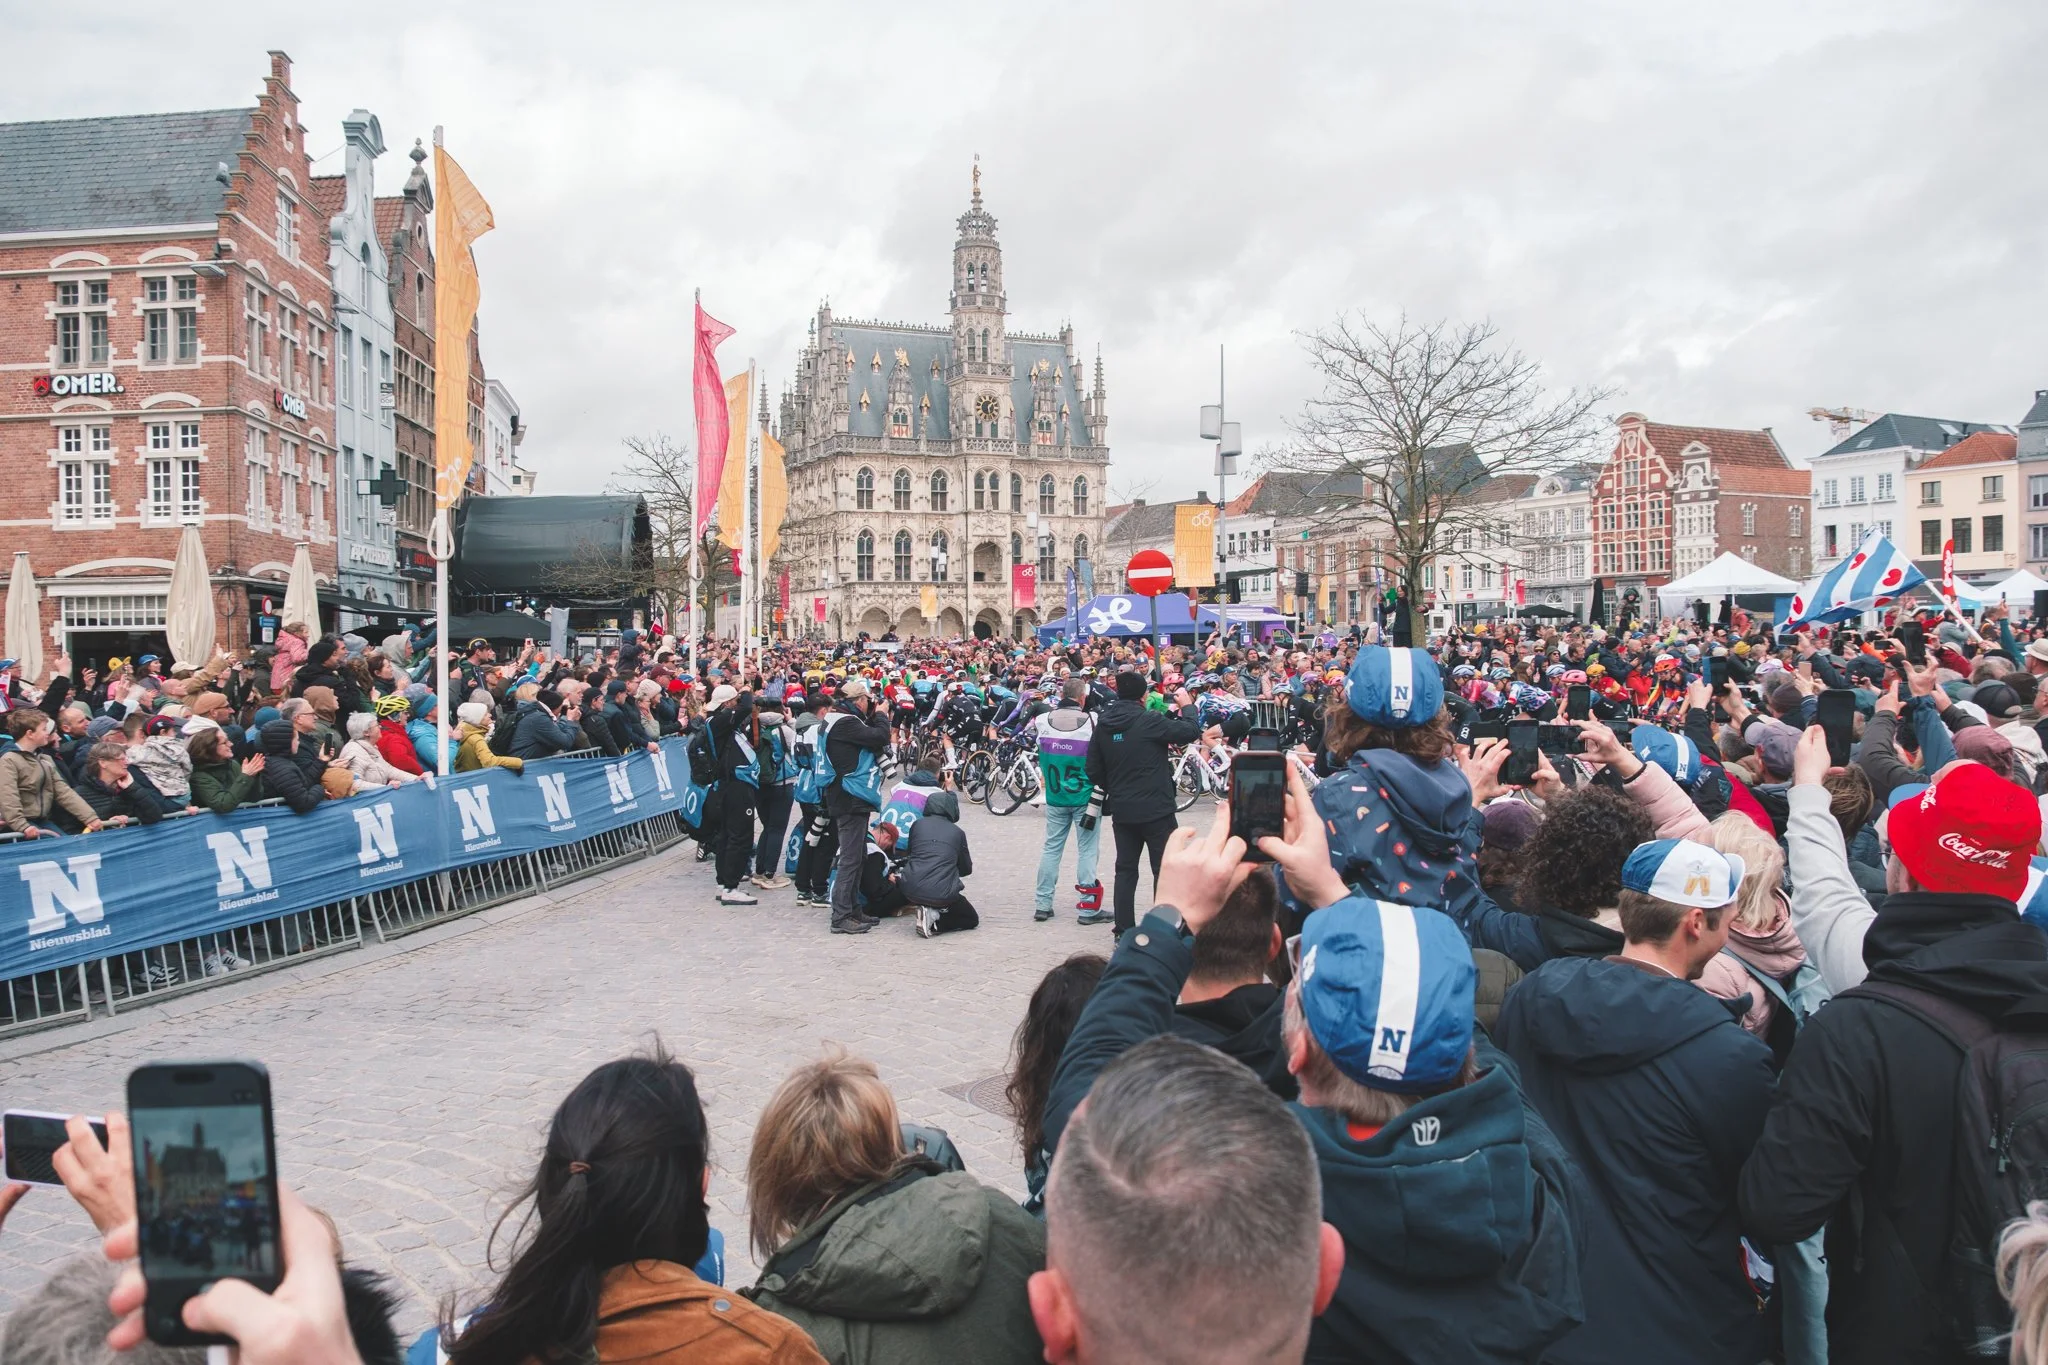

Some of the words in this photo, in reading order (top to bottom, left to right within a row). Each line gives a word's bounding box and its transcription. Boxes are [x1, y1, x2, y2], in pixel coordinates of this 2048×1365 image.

[1395, 686, 1409, 700] N
[1051, 742, 1073, 751] Photo
[605, 760, 634, 804] N
[650, 750, 672, 792] N
[1048, 764, 1083, 794] 05
[452, 784, 496, 841] N
[537, 772, 572, 822] N
[352, 803, 399, 865] N
[465, 837, 501, 852] Nieuwsblad
[205, 825, 272, 896] N
[1938, 833, 2012, 869] Coca-Cola
[360, 859, 403, 877] Nieuwsblad
[19, 853, 104, 935] N
[218, 889, 279, 911] Nieuwsblad
[30, 924, 111, 951] Nieuwsblad
[1378, 1026, 1406, 1053] N
